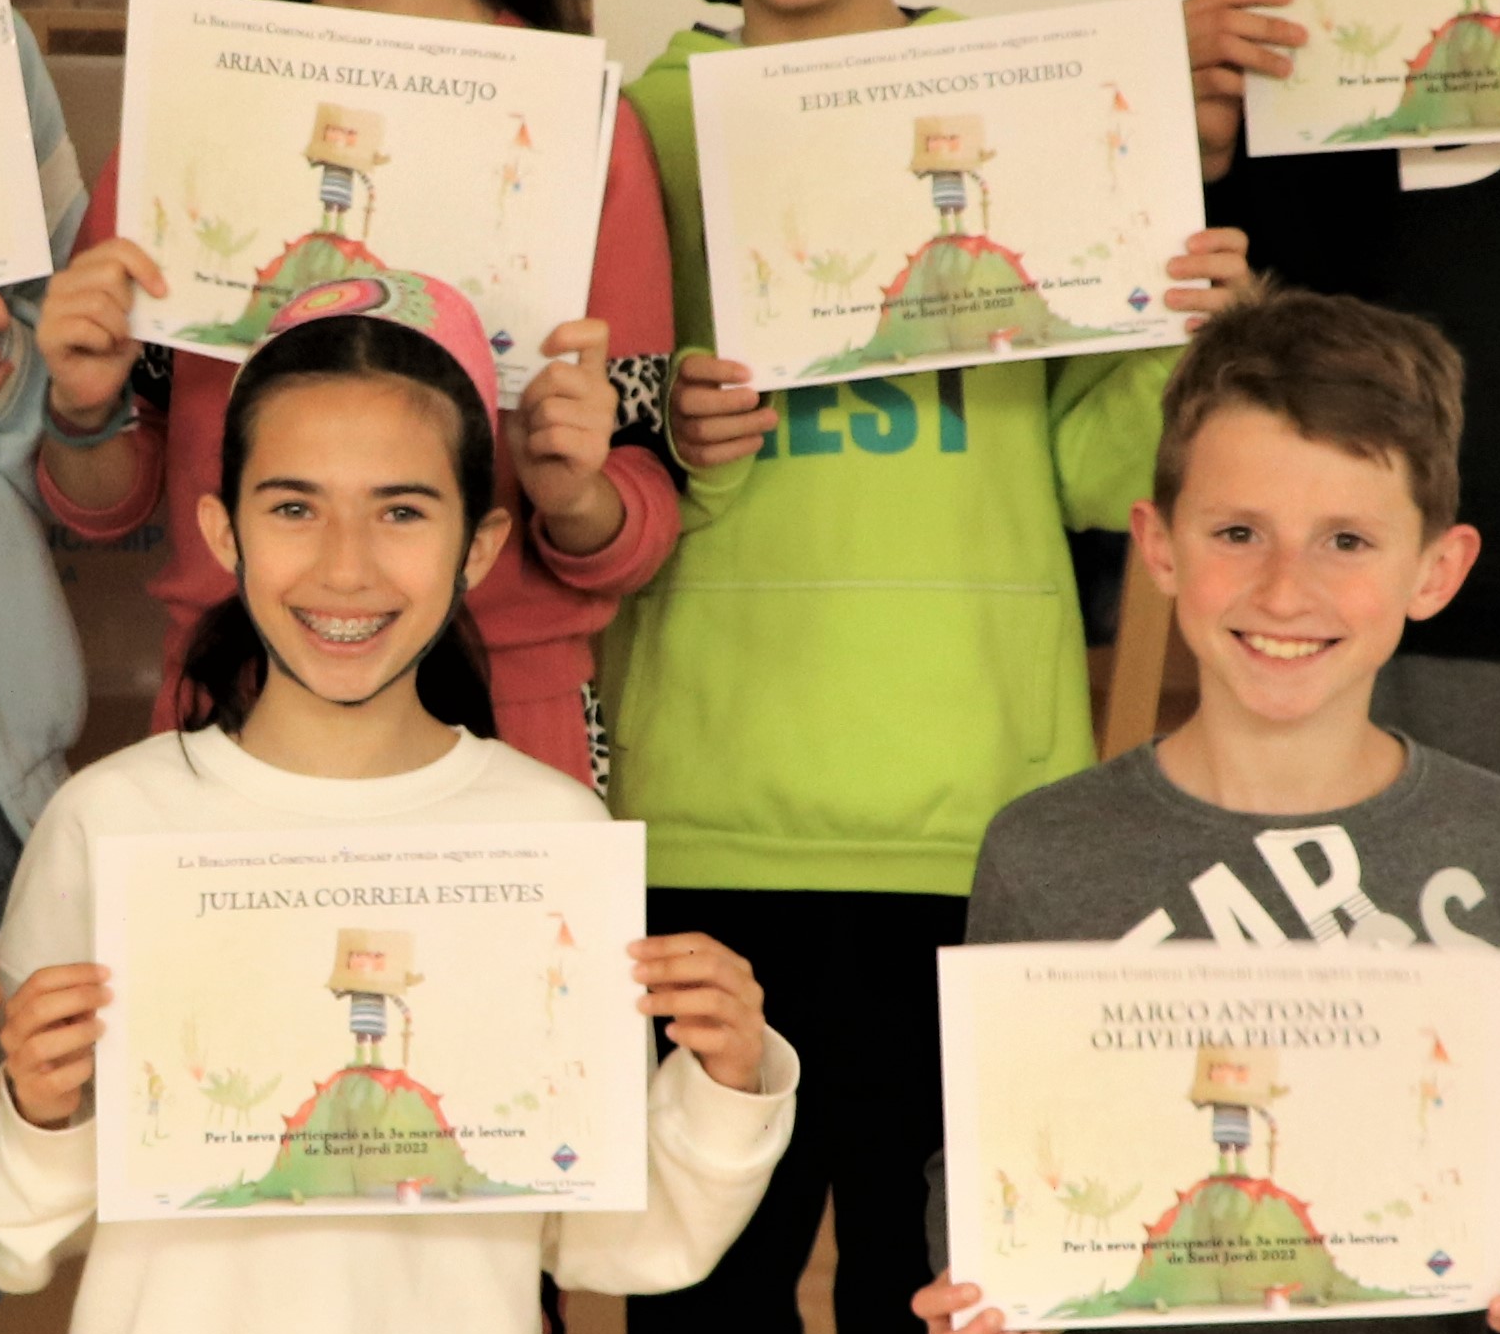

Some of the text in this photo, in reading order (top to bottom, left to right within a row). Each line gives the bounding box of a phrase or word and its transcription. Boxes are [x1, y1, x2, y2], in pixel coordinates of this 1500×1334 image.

[216, 50, 496, 104] ARIANA DA SILVA ARAUJO
[800, 60, 1082, 111] EDER VIVANCOS TORIBIO
[198, 883, 544, 916] JULIANA CORREIA ESTEVES
[1103, 1001, 1363, 1023] MARCO ANTONIO
[1091, 1028, 1234, 1048] OLIVEIRA
